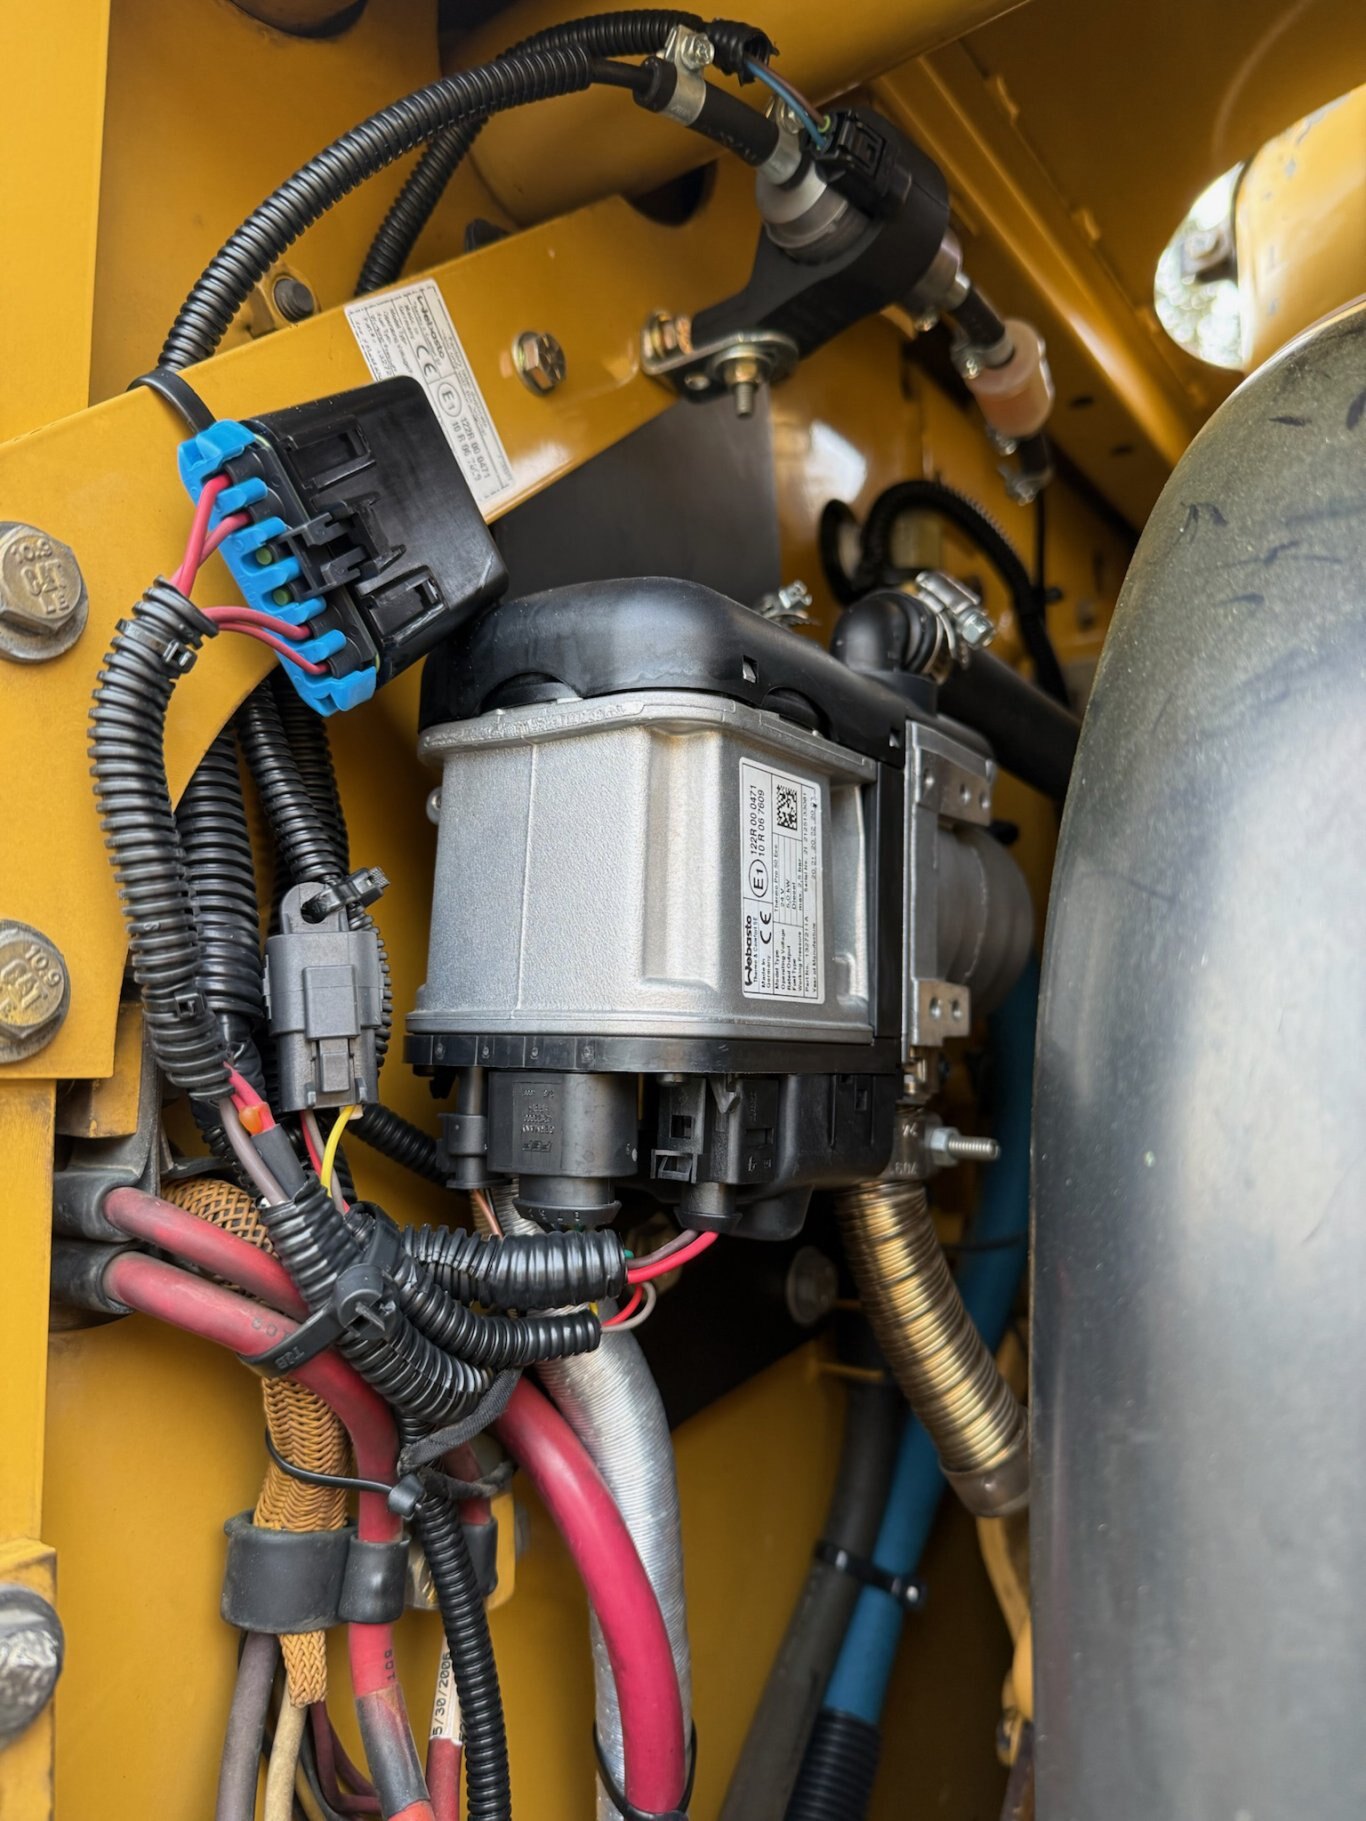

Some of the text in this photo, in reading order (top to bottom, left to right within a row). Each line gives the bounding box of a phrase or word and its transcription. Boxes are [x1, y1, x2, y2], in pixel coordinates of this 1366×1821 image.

[416, 294, 446, 359] Webasto
[460, 416, 474, 440] 122R
[751, 812, 757, 826] 00
[758, 818, 764, 830] 06
[758, 833, 764, 842] R
[759, 845, 765, 856] 10
[786, 879, 790, 893] kW
[781, 897, 784, 907] 24
[760, 911, 771, 944] CE
